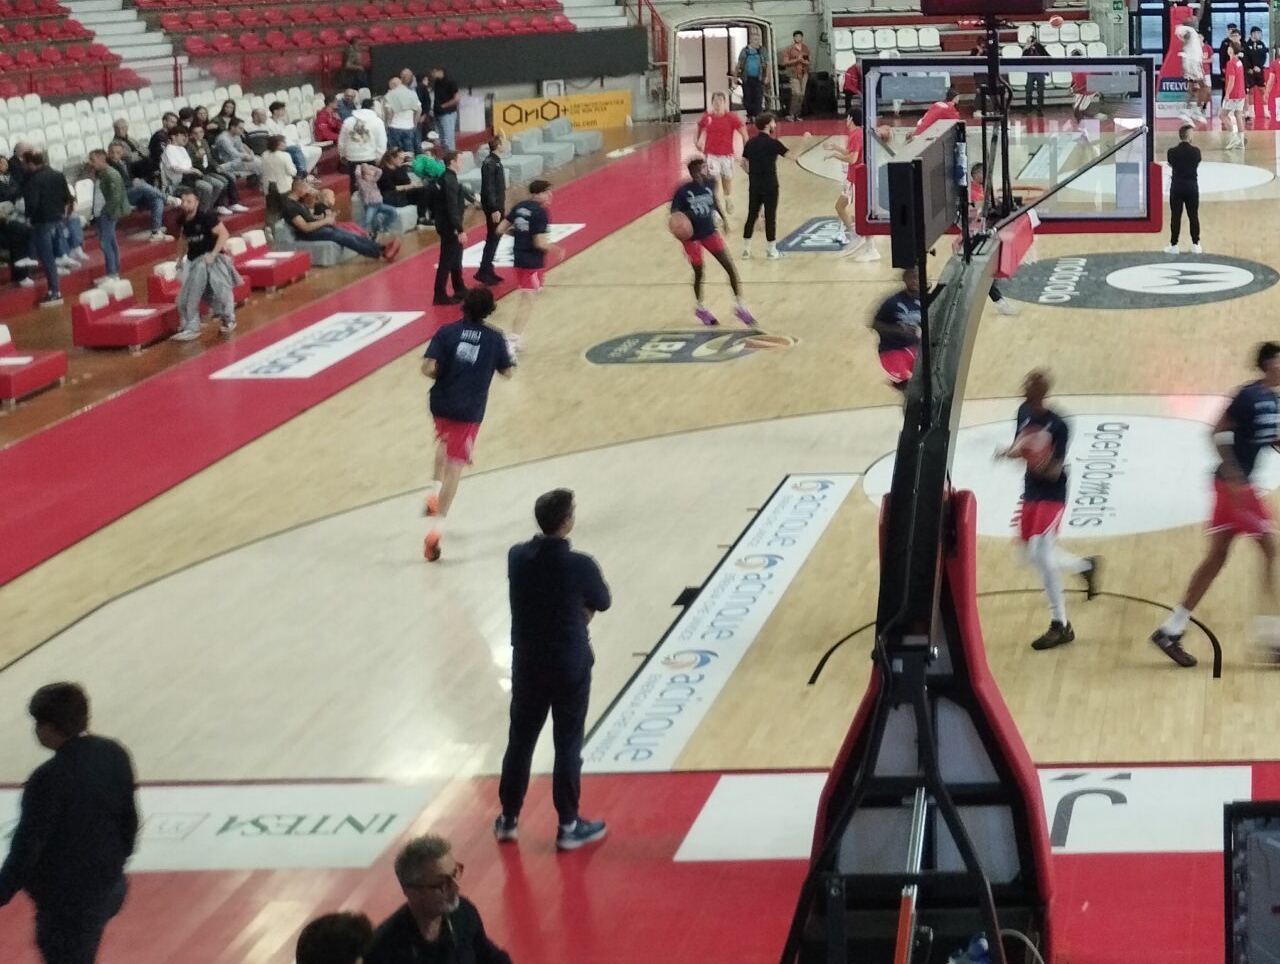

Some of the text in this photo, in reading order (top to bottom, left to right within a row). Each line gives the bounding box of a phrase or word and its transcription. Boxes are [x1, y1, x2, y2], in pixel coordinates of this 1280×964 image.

[1038, 257, 1088, 303] motorola
[767, 494, 827, 548] acinque
[701, 572, 774, 641] acinque
[614, 673, 705, 763] acinque
[215, 812, 398, 837] INTESA
